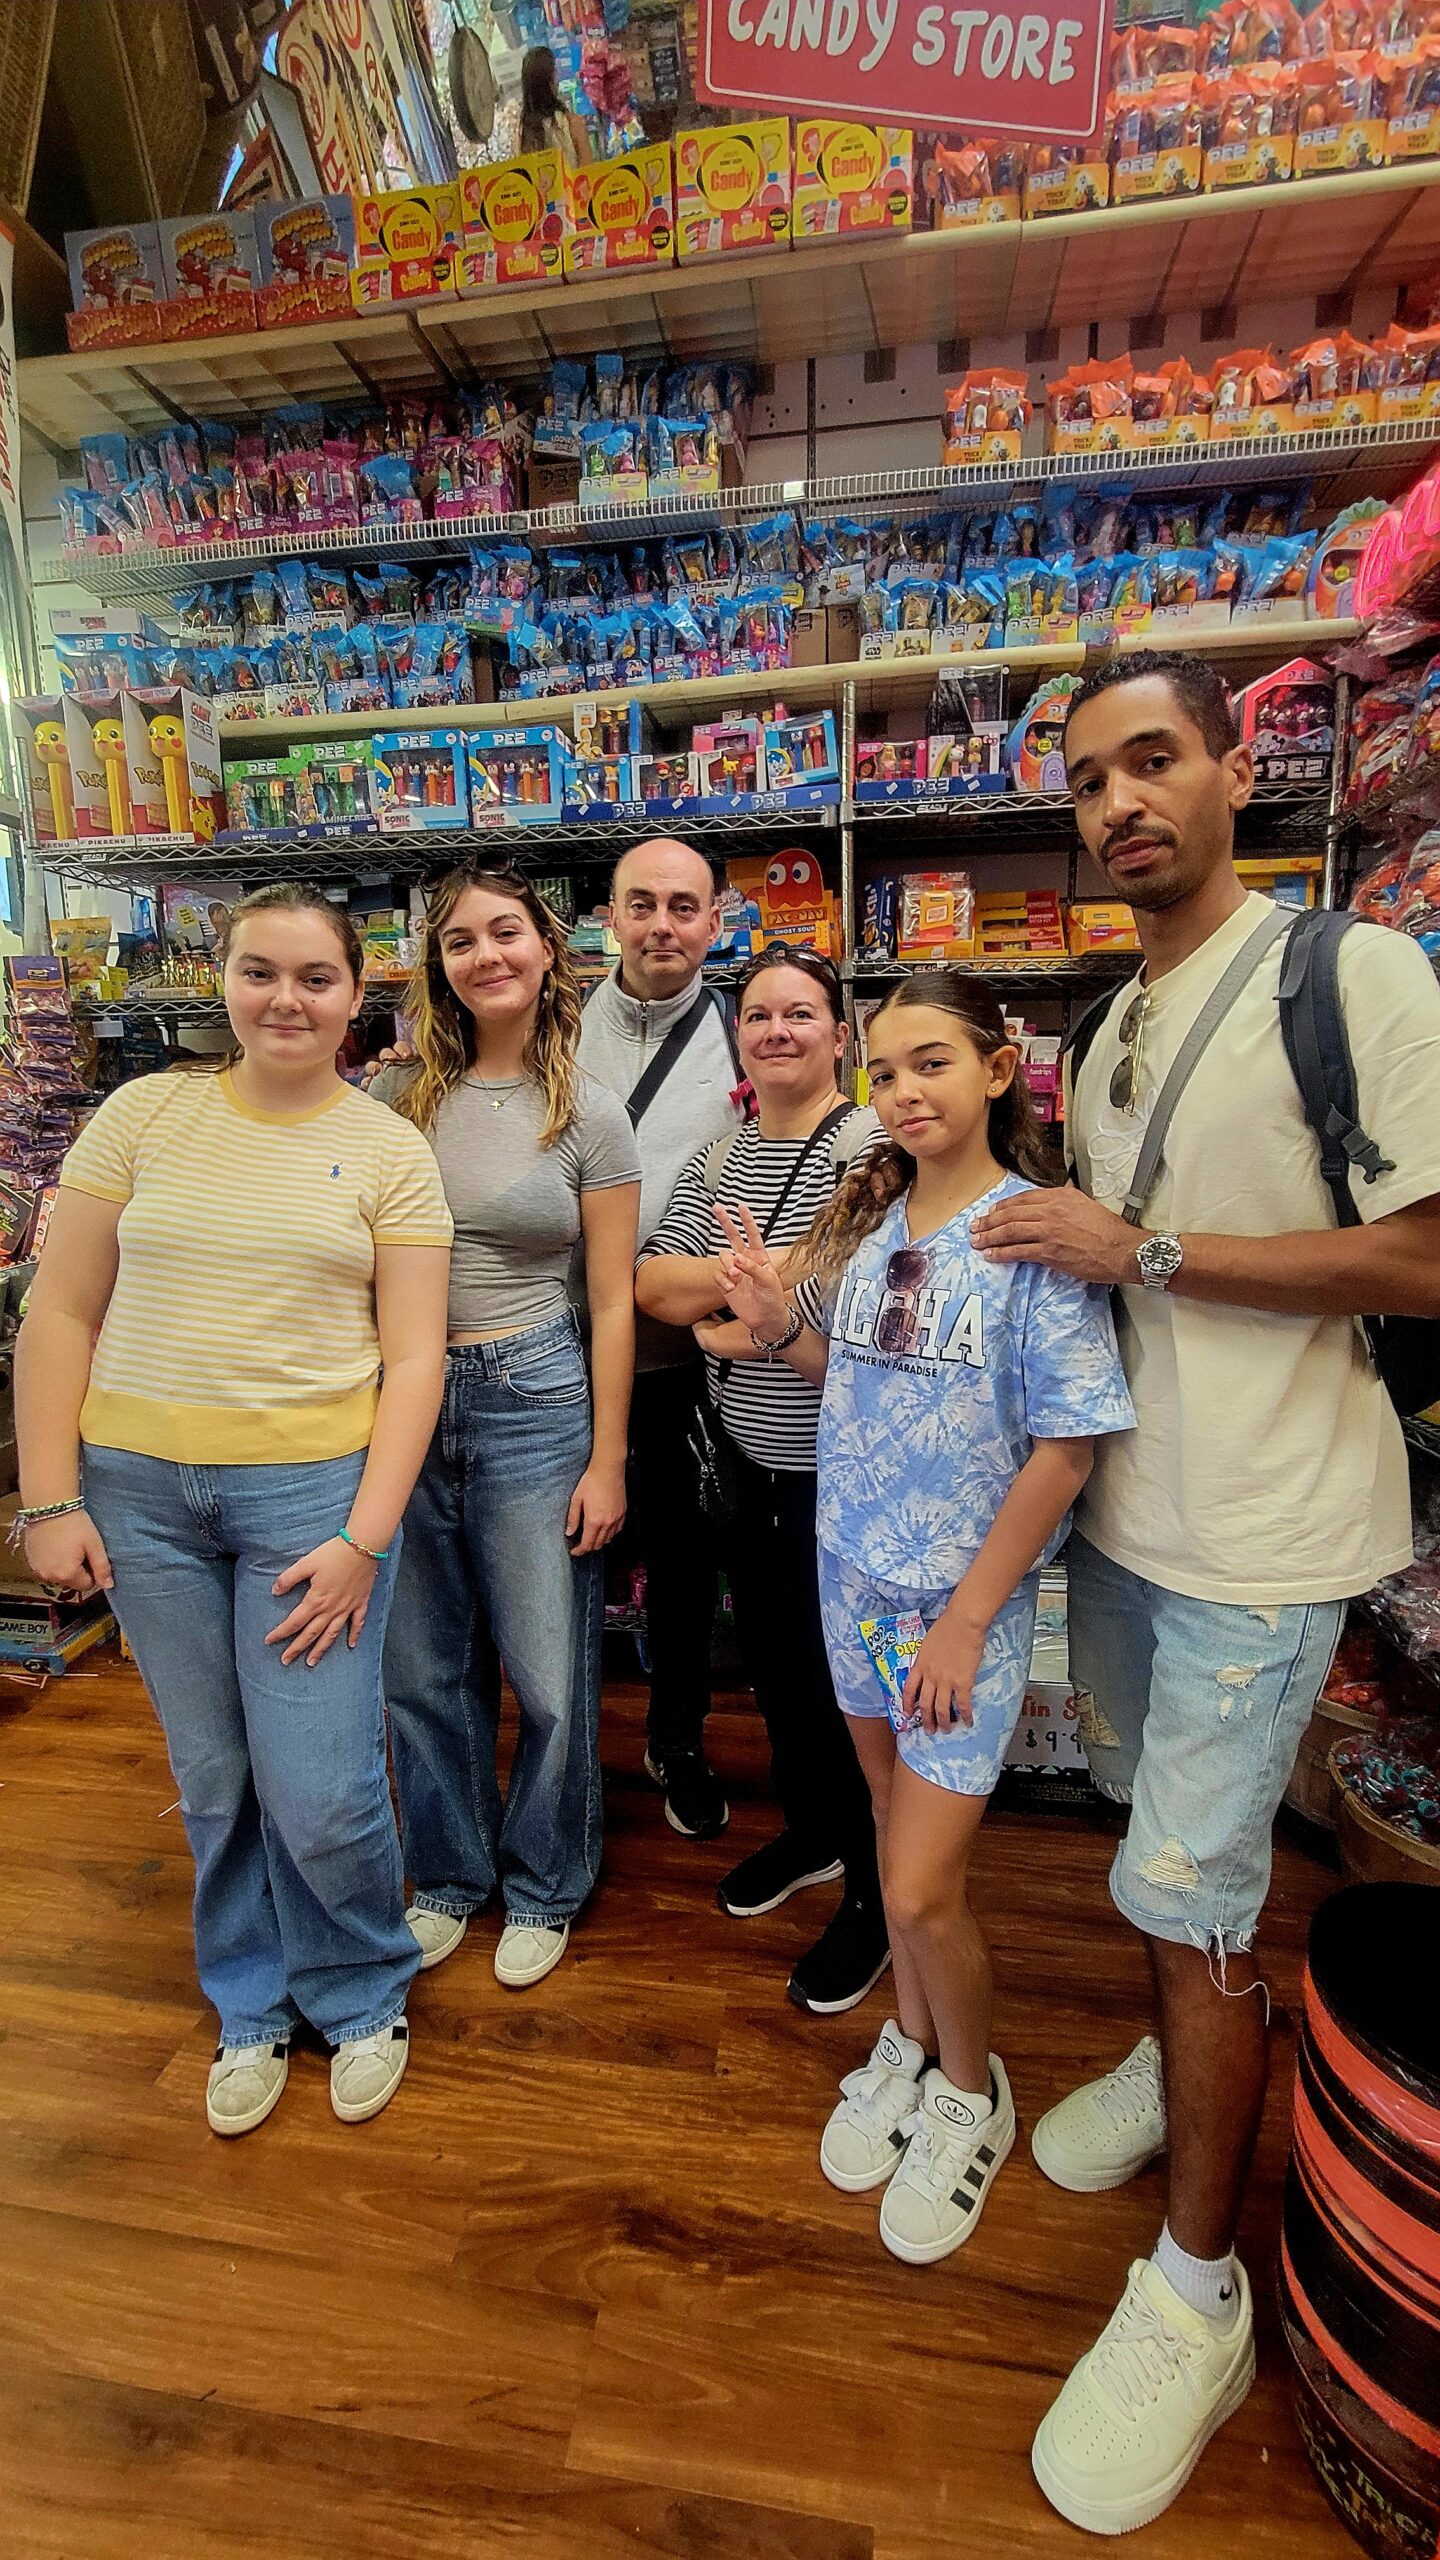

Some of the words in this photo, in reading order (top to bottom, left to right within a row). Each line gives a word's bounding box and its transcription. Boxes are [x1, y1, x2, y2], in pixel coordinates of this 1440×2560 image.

[727, 0, 898, 72] CANDY
[912, 5, 1083, 85] STORE
[831, 150, 876, 178] Candy
[710, 166, 753, 191] Candy
[492, 199, 534, 225] Candy
[601, 197, 640, 224] Candy
[392, 227, 432, 251] Candy
[436, 489, 464, 503] PEZ
[297, 508, 325, 523] PEZ
[361, 501, 388, 517] PEZ
[174, 520, 202, 535] PEZ
[239, 518, 265, 532] PEZ
[466, 596, 491, 610] PEZ
[75, 639, 105, 651] PEZ
[655, 654, 685, 669] PEZ
[519, 668, 549, 684] PEZ
[587, 663, 616, 678] PEZ
[399, 734, 431, 749] PEZ
[494, 732, 528, 746] PEZ
[315, 744, 346, 759] PEZ
[248, 761, 278, 775] PEZ
[1267, 758, 1325, 780] PEZ
[913, 778, 950, 796] PEZ
[751, 791, 788, 811] PEZ
[479, 813, 505, 822] SONIC
[613, 801, 648, 819] PEZ
[384, 814, 411, 824] SONIC
[325, 826, 352, 837] PEZ
[88, 838, 126, 846] PIKACHU
[769, 909, 824, 925] PAC-MAN
[775, 927, 797, 935] GHOST
[798, 925, 816, 933] SOUR
[841, 1349, 877, 1368] SUMMER
[878, 1359, 891, 1370] IN
[892, 1360, 939, 1378] PARADISE
[28, 1623, 49, 1635] BOY
[867, 1626, 885, 1647] POP
[871, 1632, 897, 1659] ROCKS
[895, 1639, 923, 1658] DIPS
